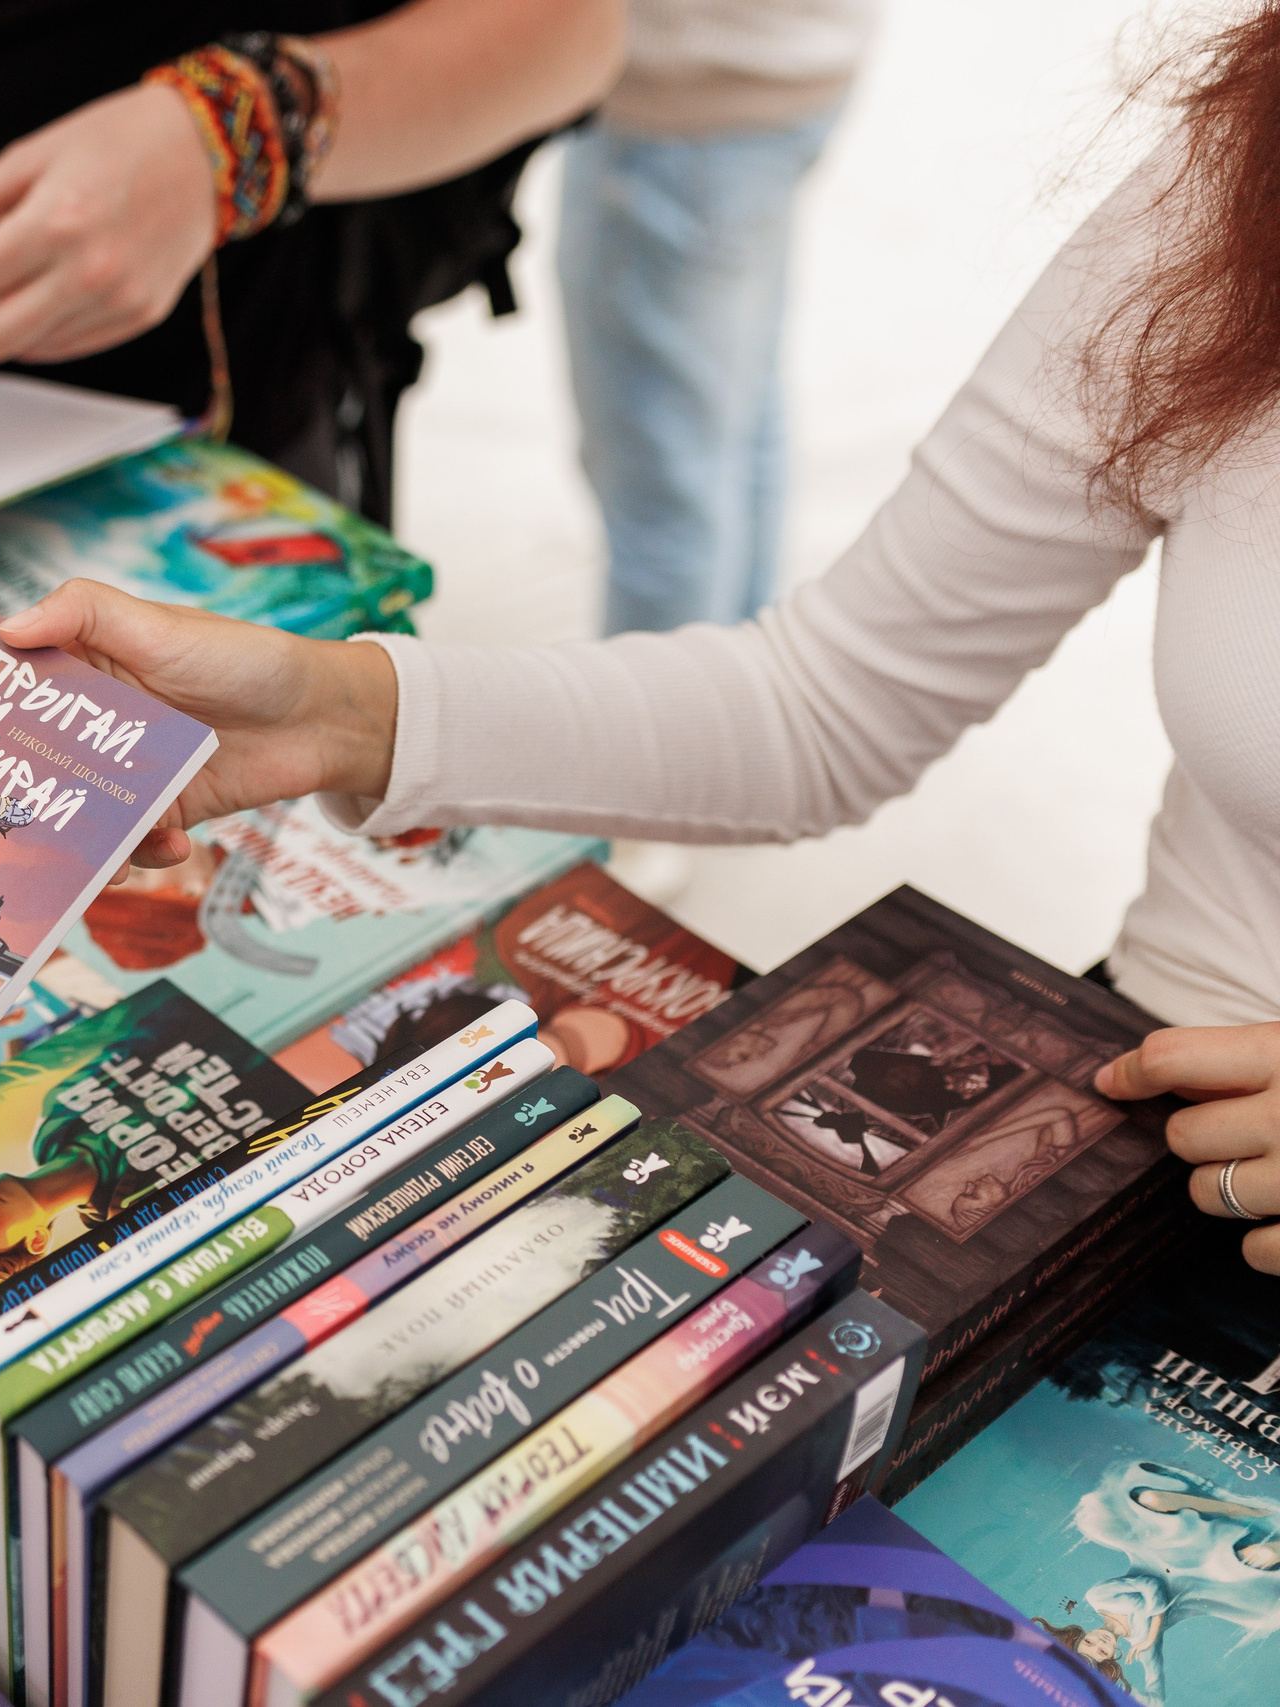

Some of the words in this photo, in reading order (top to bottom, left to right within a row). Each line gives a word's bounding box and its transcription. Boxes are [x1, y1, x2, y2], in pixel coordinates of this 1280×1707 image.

[7, 726, 73, 771] НИКОЛАЙ
[75, 763, 138, 805] ШОЛОХОВ
[516, 900, 734, 1022] ОКУРСНИЦА
[152, 1041, 277, 1142] ОСТЕЙ
[332, 1079, 401, 1132] НЕМЕШ
[398, 1061, 433, 1090] ЕВА
[56, 1076, 202, 1189] ЕОРИЯ
[262, 1126, 326, 1179] Белый
[375, 1097, 450, 1154] ЕЛЕНА
[435, 1132, 495, 1186] ЕВГЕНИЙ
[289, 1139, 382, 1209] БОРОДА
[344, 1166, 444, 1245] РУДАШЕВСКИЙ
[456, 1169, 522, 1219] никому
[227, 1213, 270, 1253] ВЫ
[381, 1224, 438, 1273] скажу
[434, 1211, 459, 1234] не
[85, 1247, 135, 1287] слон
[146, 1275, 174, 1304] С
[168, 1233, 235, 1292] УШЛИ
[221, 1243, 330, 1326] ПОЖИРАТЕЛЬ
[443, 1219, 566, 1314] ОБЛАЧНЫЙ
[586, 1262, 674, 1342] Три
[28, 1289, 152, 1382] МАРШРУТА
[375, 1305, 442, 1359] ПОЛК
[541, 1317, 608, 1370] повести
[920, 1293, 1011, 1383] НАЛИЧН
[412, 1367, 535, 1469] войне
[728, 1358, 820, 1441] МЭЙ
[1147, 1385, 1280, 1475] КАРИМОВА
[470, 1422, 593, 1528] ТЕОРИЯ
[492, 1430, 729, 1622] ИМПЕРИЯ
[365, 1597, 508, 1707] ГРЁЗ
